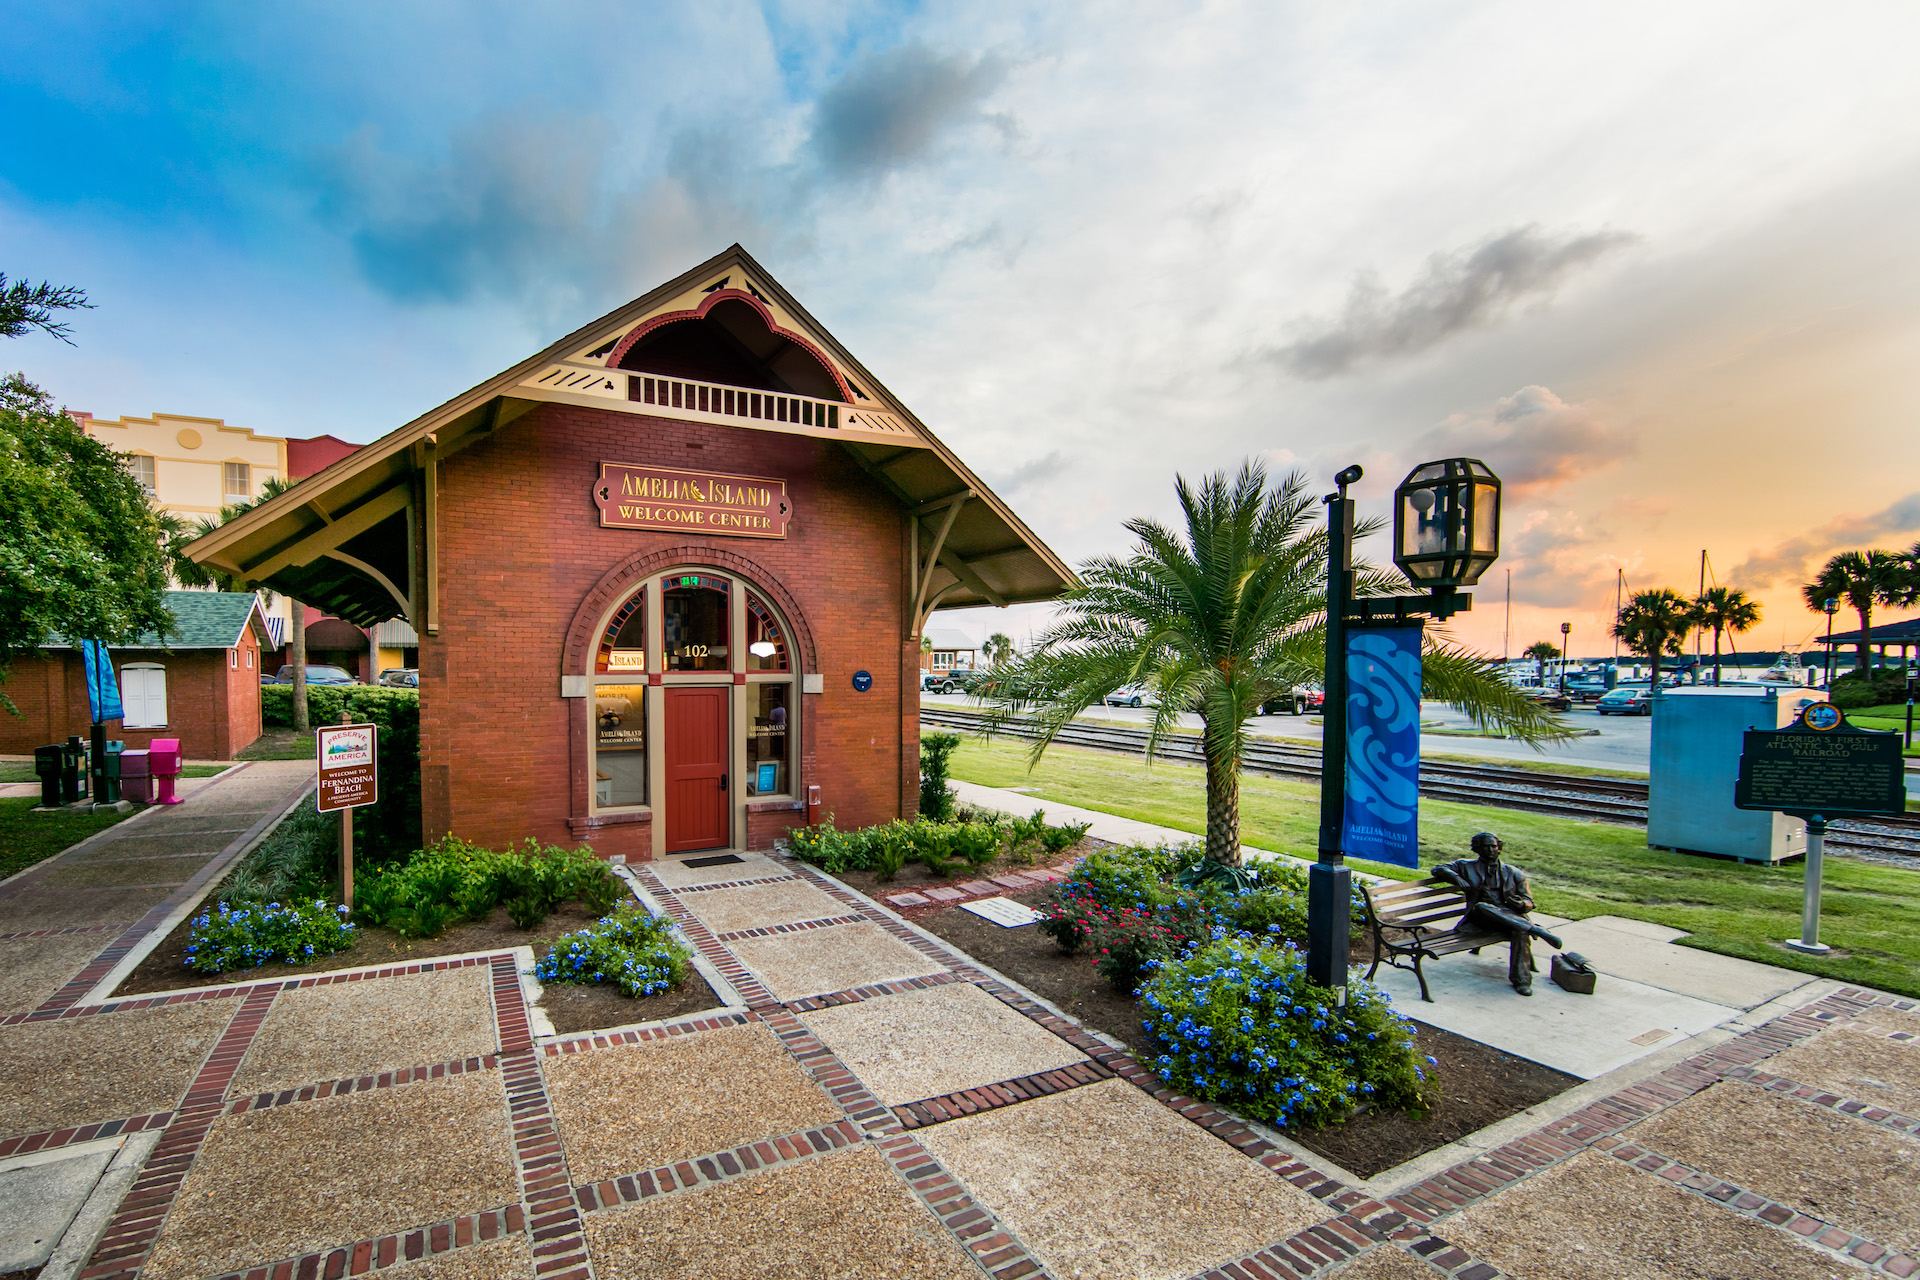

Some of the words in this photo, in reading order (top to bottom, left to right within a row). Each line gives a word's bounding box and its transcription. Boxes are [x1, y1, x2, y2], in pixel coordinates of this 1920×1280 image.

[621, 472, 691, 500] AMELIA
[709, 479, 771, 507] ISLAND
[618, 505, 705, 525] WELCOME
[709, 512, 772, 529] CENTER
[684, 645, 709, 659] 102
[614, 655, 642, 666] ISLAND
[327, 731, 368, 745] PRESERVE
[1775, 735, 1831, 744] FLORIDA'S
[1838, 736, 1870, 744] FIRST
[1765, 742, 1822, 750] ATLANTIC
[1851, 743, 1880, 751] GULF
[328, 752, 367, 762] AMERICA
[1793, 749, 1850, 757] RAILROAD
[329, 770, 357, 778] WELCOME
[322, 775, 373, 788] FERNANDINA
[334, 784, 362, 795] BEACH
[1350, 823, 1378, 835] AMELIA
[1383, 828, 1408, 842] ISLAND
[1351, 834, 1383, 843] WELCOME
[1383, 840, 1405, 849] CENTER
